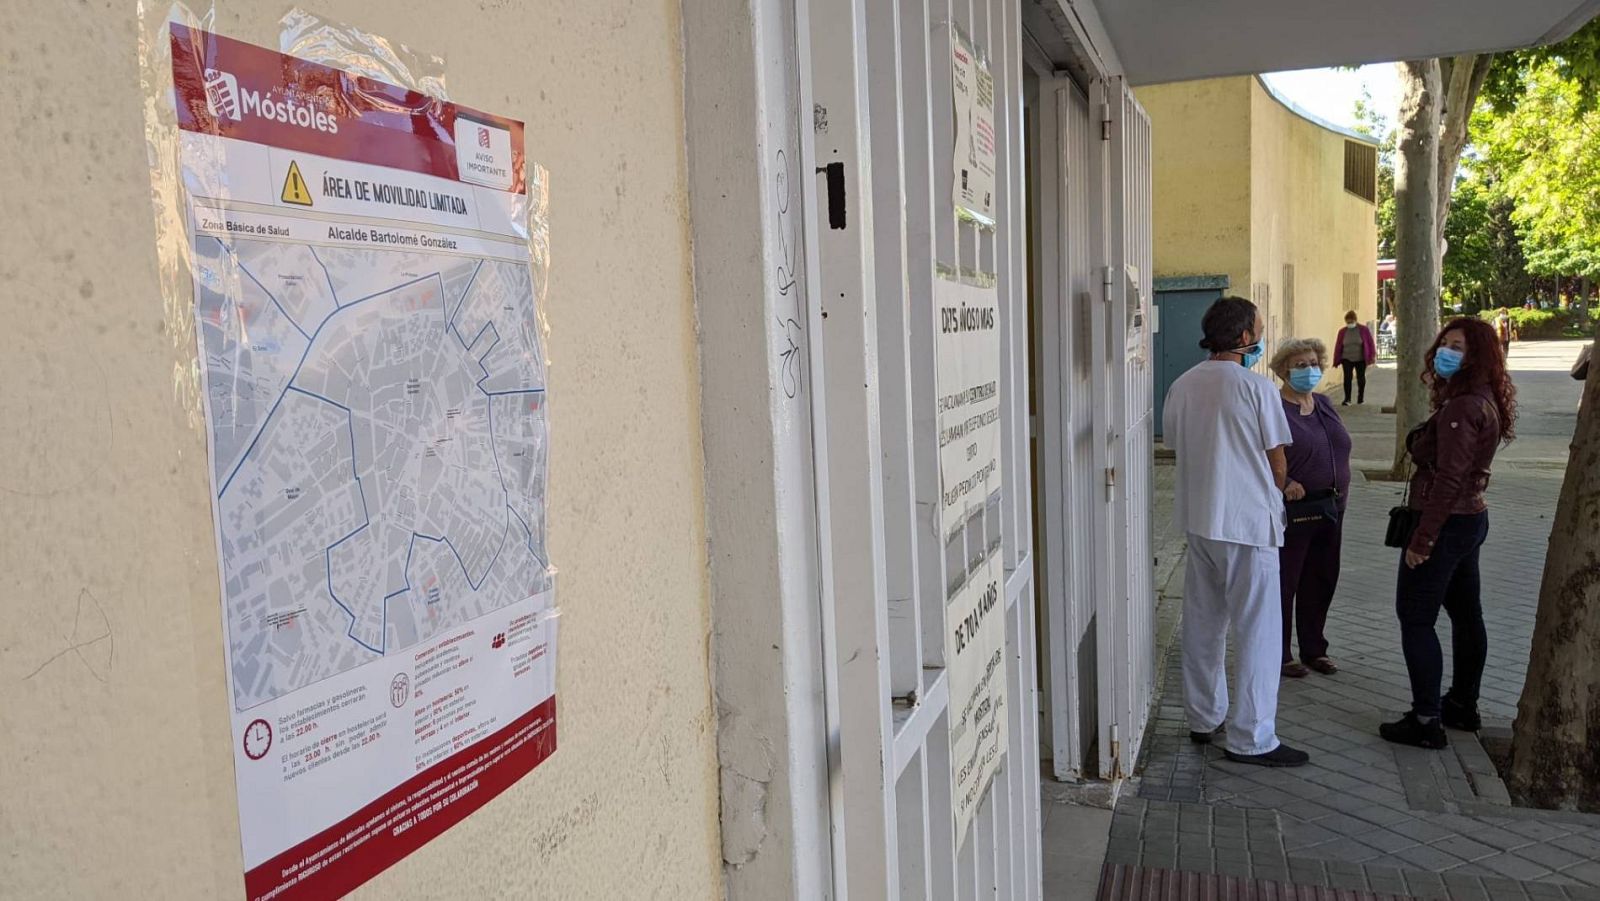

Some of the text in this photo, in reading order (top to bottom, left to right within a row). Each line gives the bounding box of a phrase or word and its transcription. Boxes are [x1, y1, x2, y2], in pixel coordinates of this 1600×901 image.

[241, 87, 338, 135] Móstoles
[466, 162, 507, 177] IMPORTANTE
[475, 152, 494, 164] AVISO
[323, 171, 468, 215] ÁREA DE MOVILIDAD LIMITADA
[202, 218, 290, 236] Zona Básica de Salud
[328, 227, 457, 250] Alcalde Bartolomé González
[955, 624, 965, 655] DE
[964, 617, 974, 643] 70
[983, 580, 997, 616] AÑOS
[279, 712, 296, 725] Salvo
[297, 701, 325, 717] farmacias
[280, 725, 289, 734] los
[291, 704, 340, 729] establecimientos
[286, 733, 295, 741] las
[296, 724, 312, 737] 22.00
[282, 755, 289, 763] El
[289, 746, 311, 760] horario
[312, 742, 319, 750] de
[320, 734, 337, 746] cierre
[284, 767, 307, 782] nuevos
[308, 756, 331, 770] clientes
[333, 747, 350, 759] desde
[351, 742, 360, 751] las
[291, 761, 300, 769] las
[305, 750, 320, 762] 23.00
[335, 740, 345, 748] sin
[349, 731, 366, 743] poder
[393, 820, 413, 837] GRACIAS
[433, 801, 443, 813] POR
[282, 862, 298, 878] Desde
[305, 840, 339, 868] Ayuntamiento
